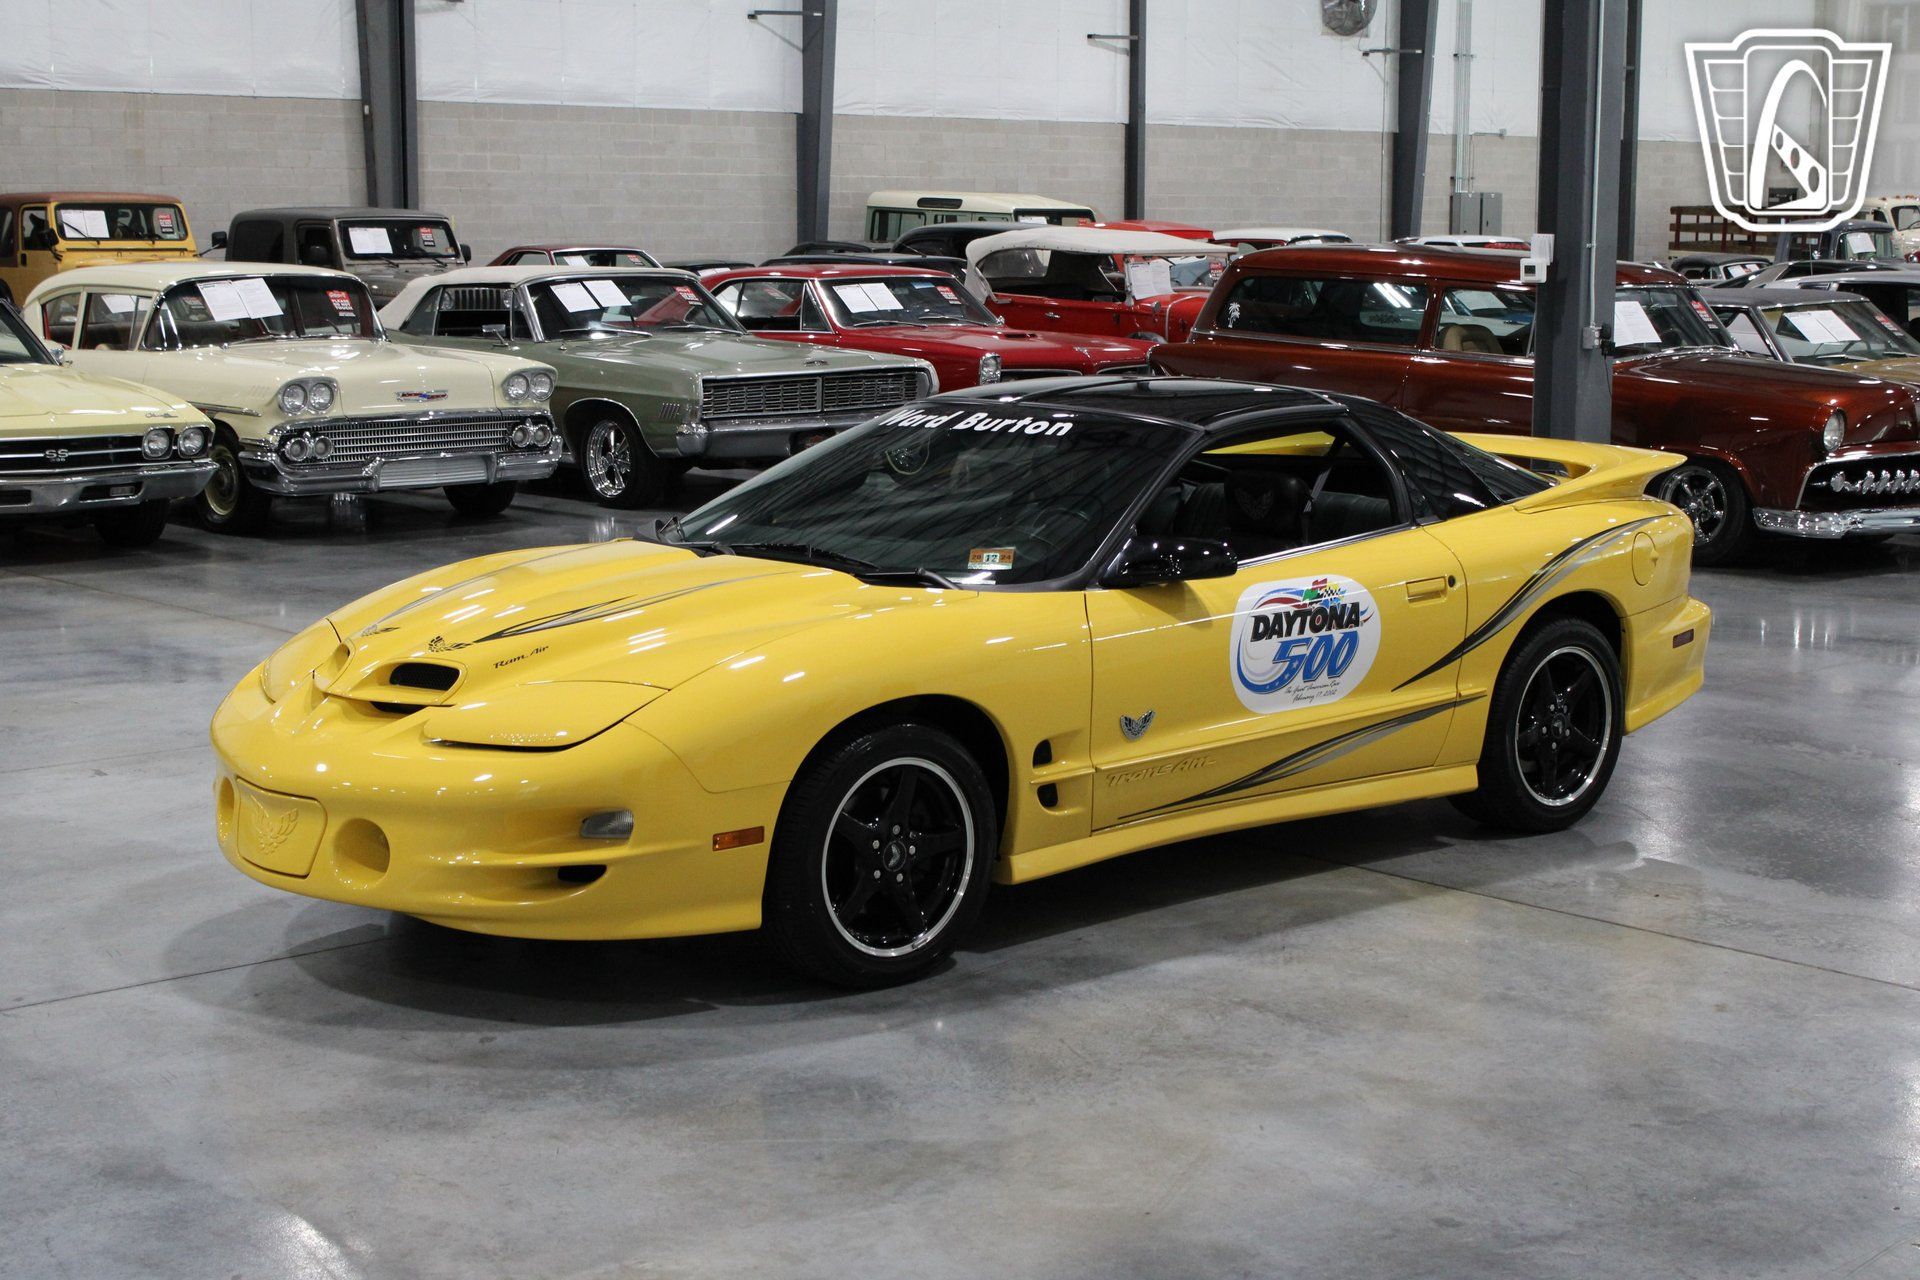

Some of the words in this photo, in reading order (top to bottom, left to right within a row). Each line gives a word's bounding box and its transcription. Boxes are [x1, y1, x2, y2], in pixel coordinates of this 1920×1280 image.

[878, 409, 964, 429] Ward
[950, 412, 1074, 436] Burton
[45, 449, 69, 459] SS
[985, 554, 998, 563] 12
[1249, 602, 1360, 643] DAYTONA
[493, 654, 528, 669] Ram
[530, 645, 549, 656] Air
[1260, 630, 1360, 690] 500
